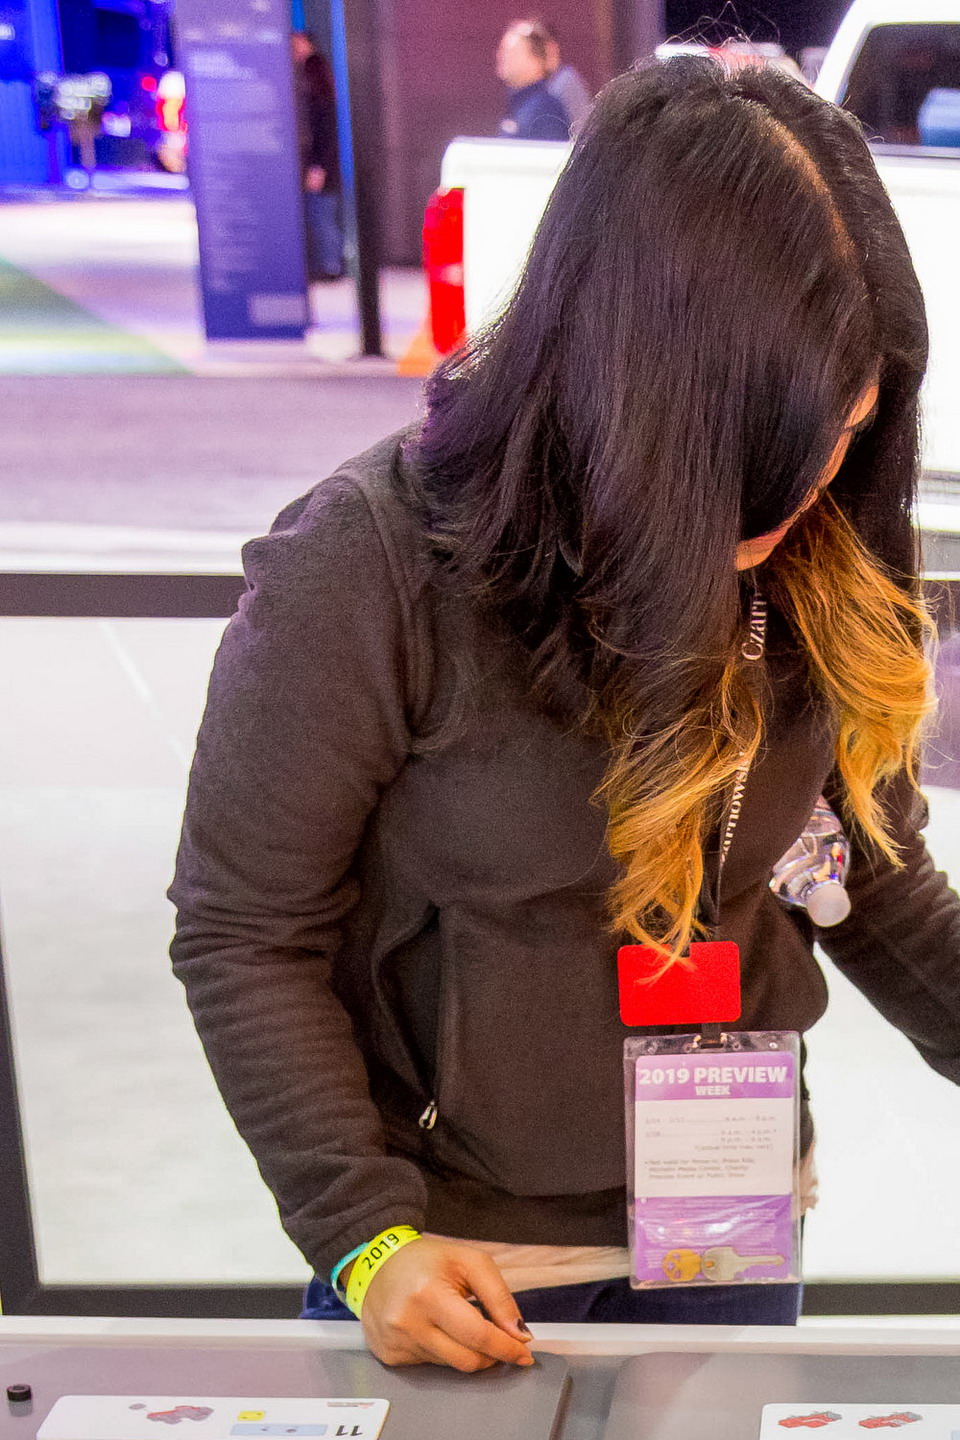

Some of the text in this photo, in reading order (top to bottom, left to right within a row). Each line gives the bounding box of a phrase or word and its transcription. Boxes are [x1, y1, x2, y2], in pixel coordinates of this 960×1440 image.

[639, 1066, 788, 1085] 2019 PREVIEW
[695, 1085, 731, 1096] WEEK
[361, 1233, 400, 1270] 2019
[335, 1424, 364, 1437] 11
